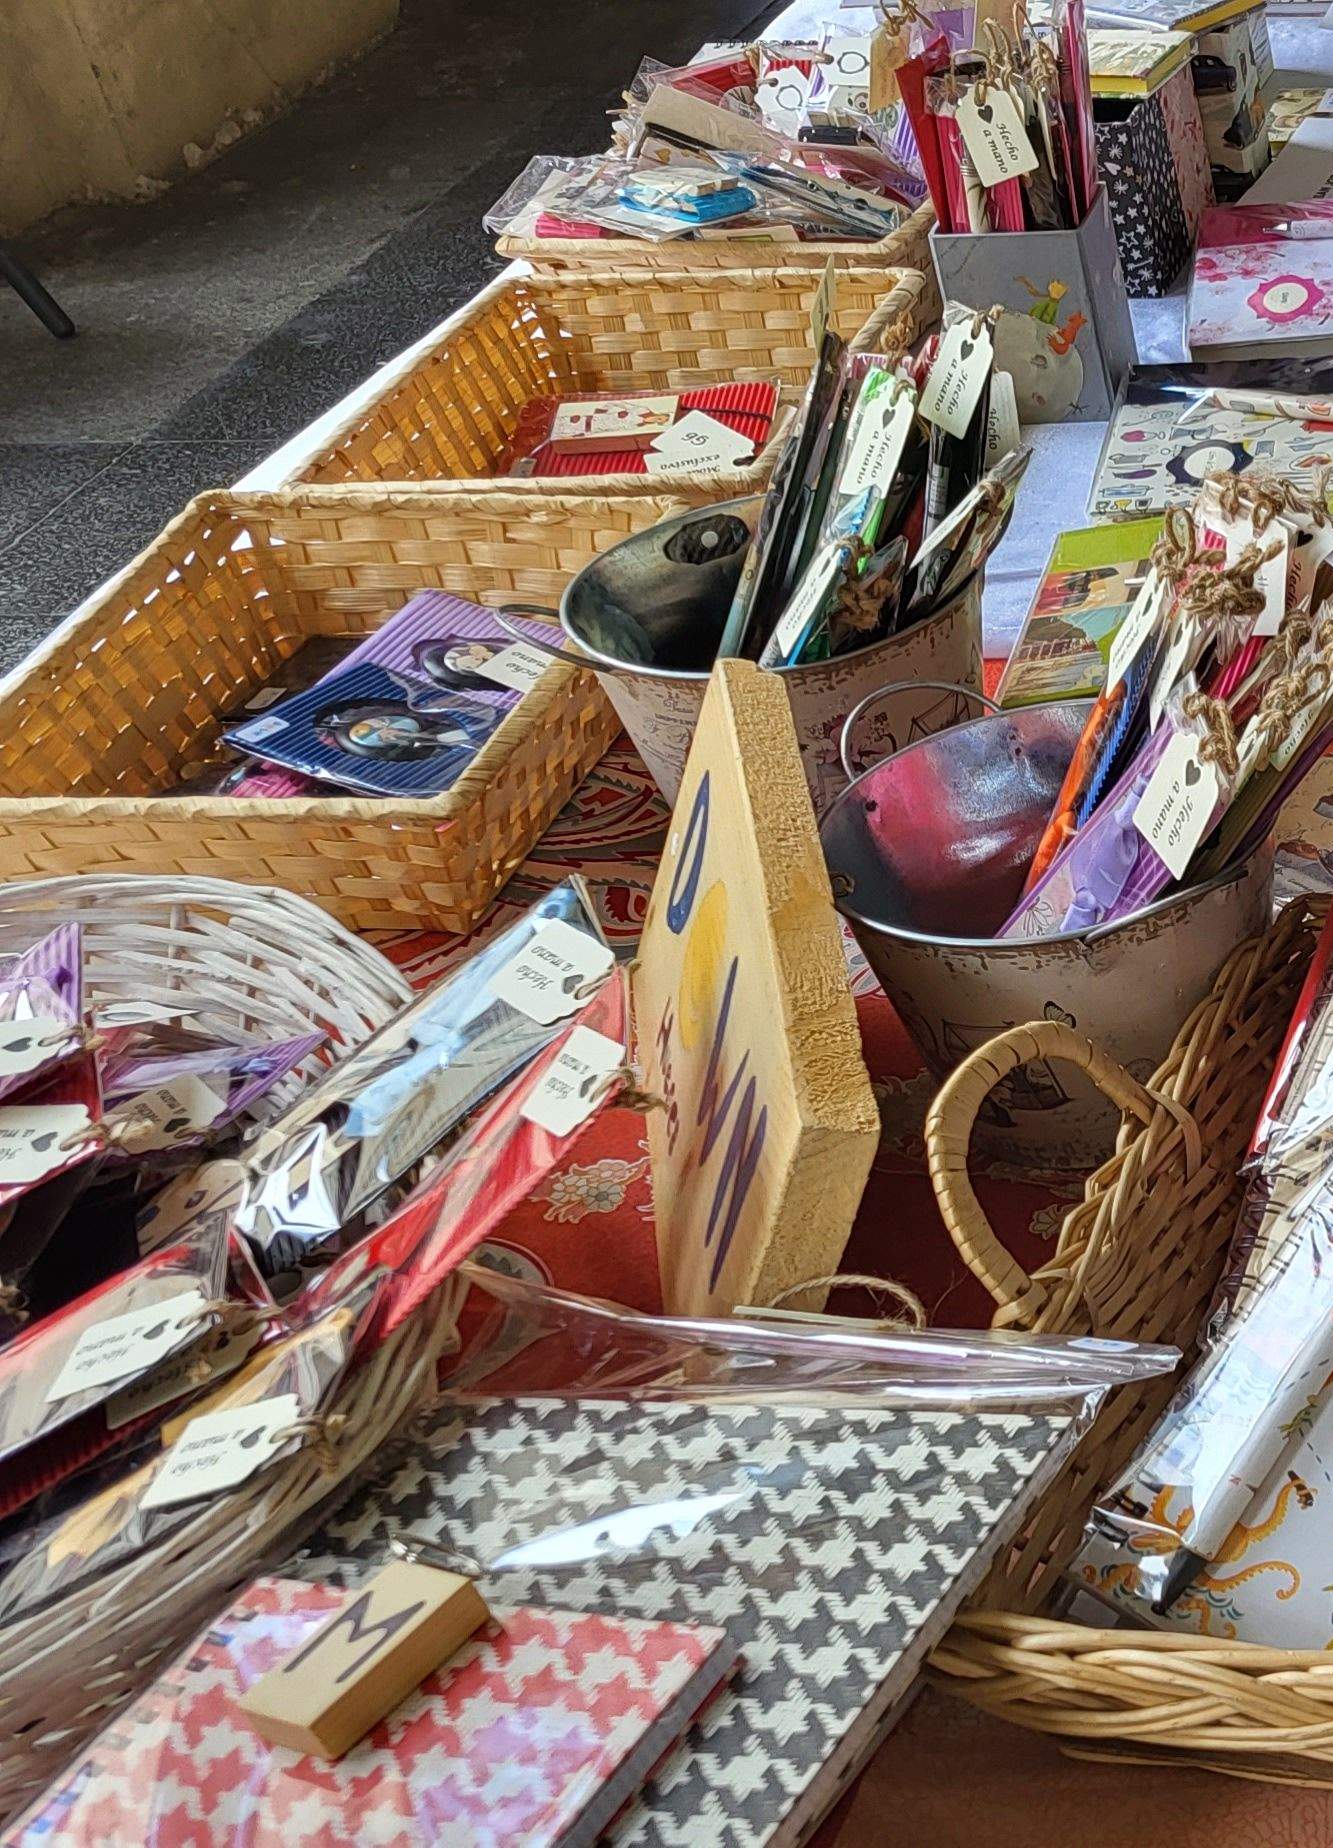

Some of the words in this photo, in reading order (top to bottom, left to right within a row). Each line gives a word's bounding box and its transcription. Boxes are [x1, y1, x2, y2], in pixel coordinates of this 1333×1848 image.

[983, 129, 992, 137] a
[988, 140, 1008, 174] mano
[996, 123, 1019, 161] Hecho
[935, 371, 954, 411] mano
[948, 369, 968, 415] Hecho
[659, 453, 721, 471] exclusivo
[857, 443, 876, 484] mano
[871, 433, 892, 478] Hecho
[1171, 780, 1181, 794] a
[1152, 795, 1175, 840] mano
[1167, 795, 1194, 847] Hecho
[530, 945, 562, 966] mano
[516, 964, 555, 991] Hecho
[283, 1590, 427, 1684] M
